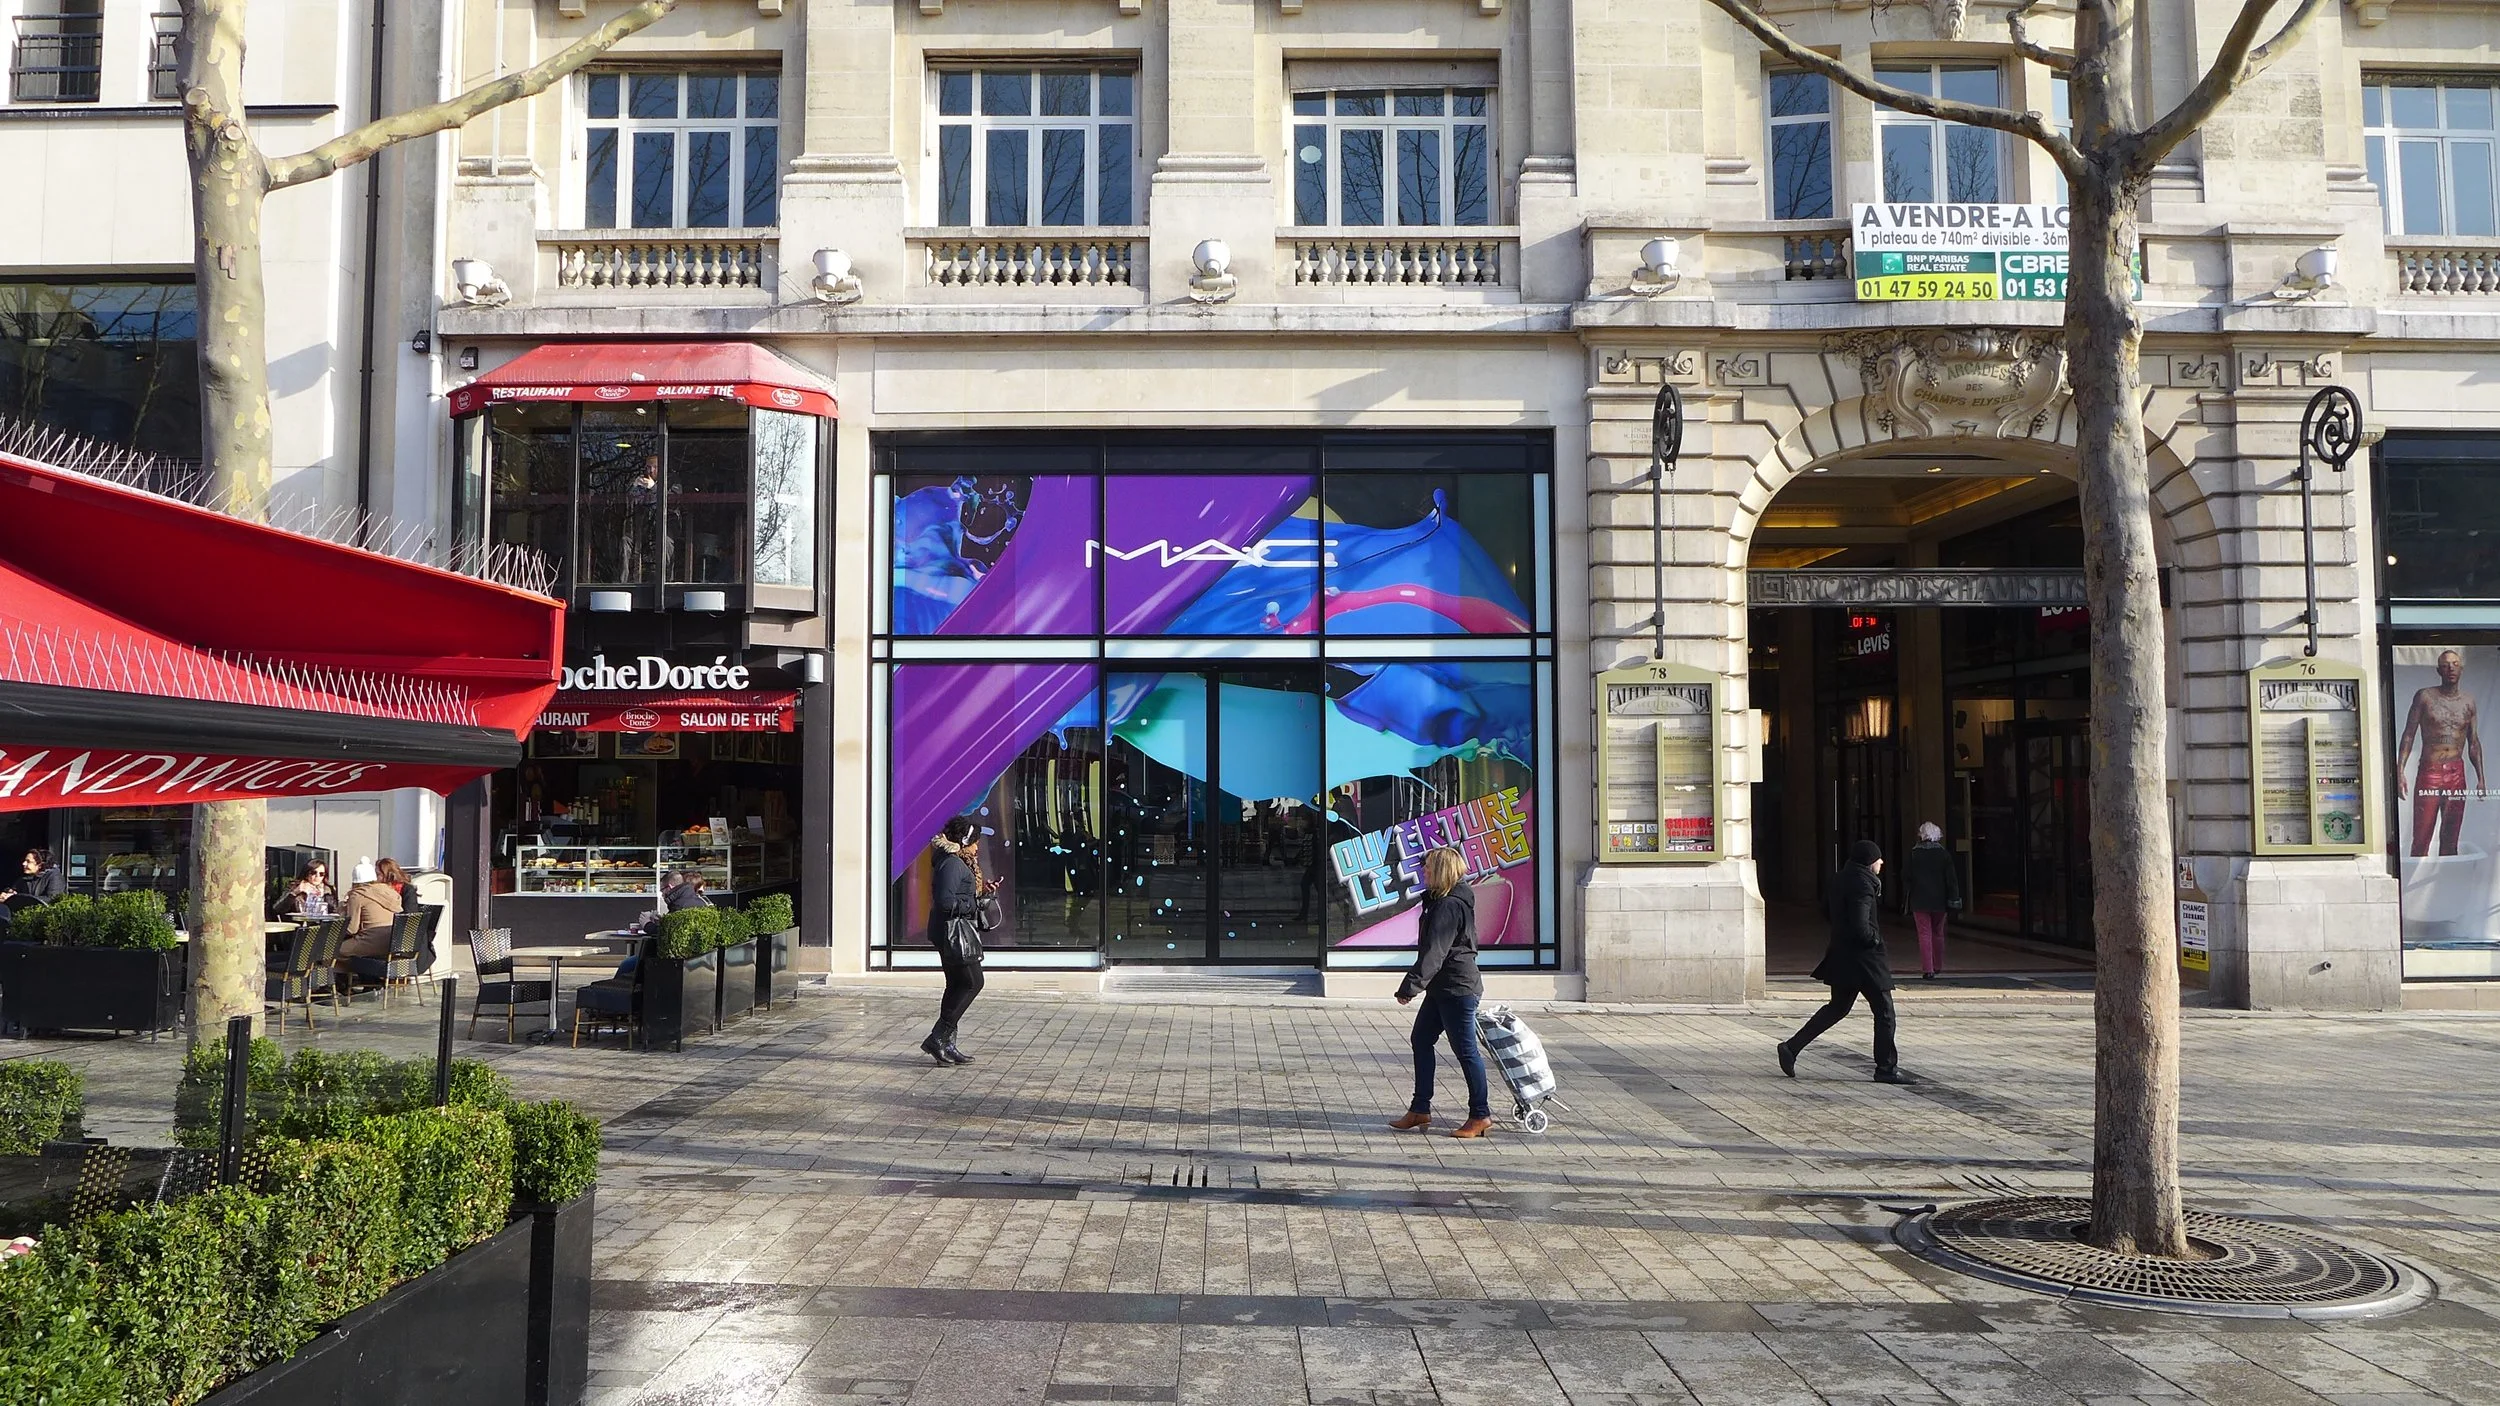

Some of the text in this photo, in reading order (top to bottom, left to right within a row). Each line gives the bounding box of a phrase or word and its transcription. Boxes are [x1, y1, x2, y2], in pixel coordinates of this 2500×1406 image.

[1861, 205, 1881, 228] A
[1888, 205, 2033, 229] VENDRE-A
[1860, 231, 1866, 245] 1
[1871, 230, 1918, 248] plateau
[1921, 231, 1937, 245] de
[1981, 232, 2031, 246] divisible
[1906, 255, 1970, 264] BNP PARIBAS
[1906, 263, 1968, 272] REAL ESTATE
[1862, 280, 1993, 298] 01 47 59 24 50
[2005, 278, 2027, 297] 01
[2033, 279, 2056, 297] 53
[1947, 361, 2009, 380] ARCADES
[491, 386, 574, 400] RESTAURANT
[656, 385, 735, 397] SALON DE THÉ
[1965, 383, 1984, 392] DES
[1913, 388, 1968, 406] CHAMPS
[1649, 667, 1667, 680] 78
[2300, 663, 2316, 676] 76
[625, 711, 655, 721] Brioche
[680, 709, 779, 727] SALON DE THÉ
[1330, 786, 1529, 885] OUVERTURE
[1347, 864, 1401, 916] LE
[1458, 822, 1532, 881] ARS
[2182, 903, 2206, 913] CHANGE
